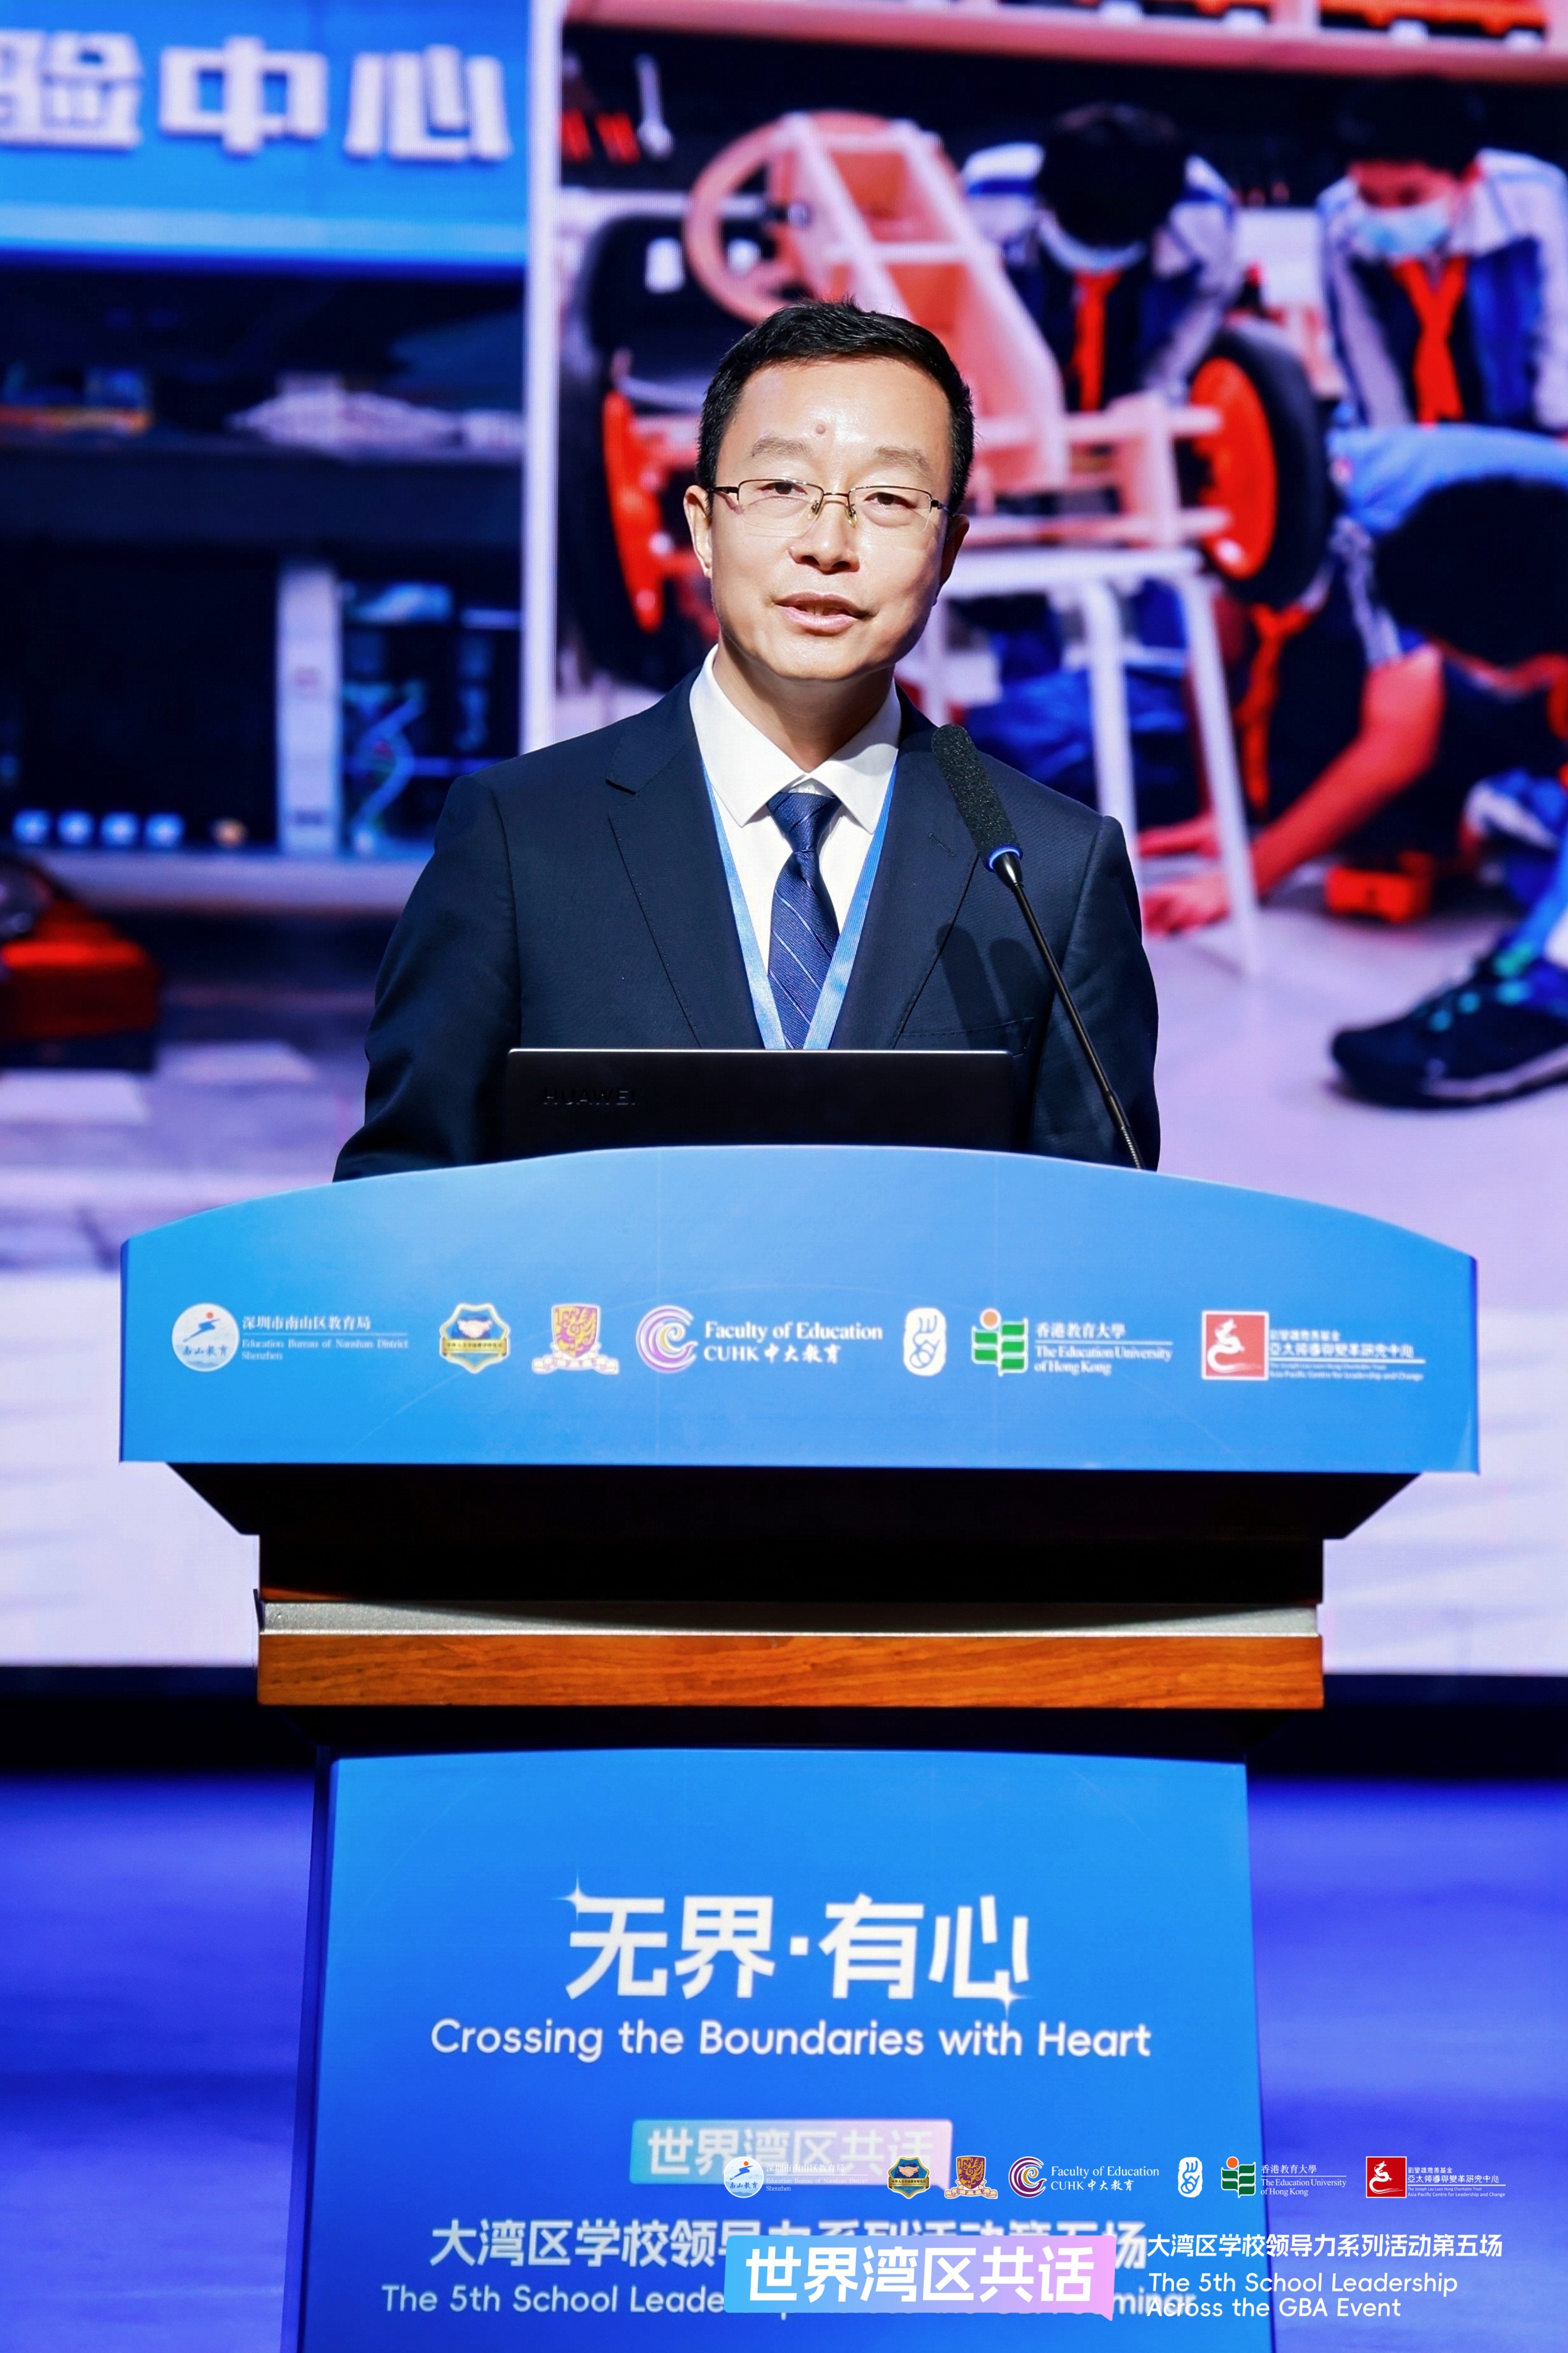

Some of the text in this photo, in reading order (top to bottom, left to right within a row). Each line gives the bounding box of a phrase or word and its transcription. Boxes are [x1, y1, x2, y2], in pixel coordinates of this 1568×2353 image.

[0, 28, 514, 162] 验中心
[543, 1087, 636, 1106] HUAWEI
[242, 1315, 371, 1331] 深圳市南山区教育局
[704, 1321, 883, 1344] Faculty of Education
[1037, 1322, 1126, 1338] 香港教育大學
[242, 1338, 409, 1350] Education Bureau of Nanshan District
[703, 1343, 842, 1364] CUHK 中大教育
[1035, 1345, 1172, 1362] The Education University
[242, 1350, 284, 1360] Shenzhen
[1035, 1360, 1112, 1376] of Hong Kong
[566, 1894, 1030, 2000] 无界·有心
[431, 2018, 1152, 2063] Crossing the Boundaries with Heart
[382, 2284, 437, 2312] The
[449, 2284, 501, 2312] 5th
[513, 2284, 618, 2312] School
